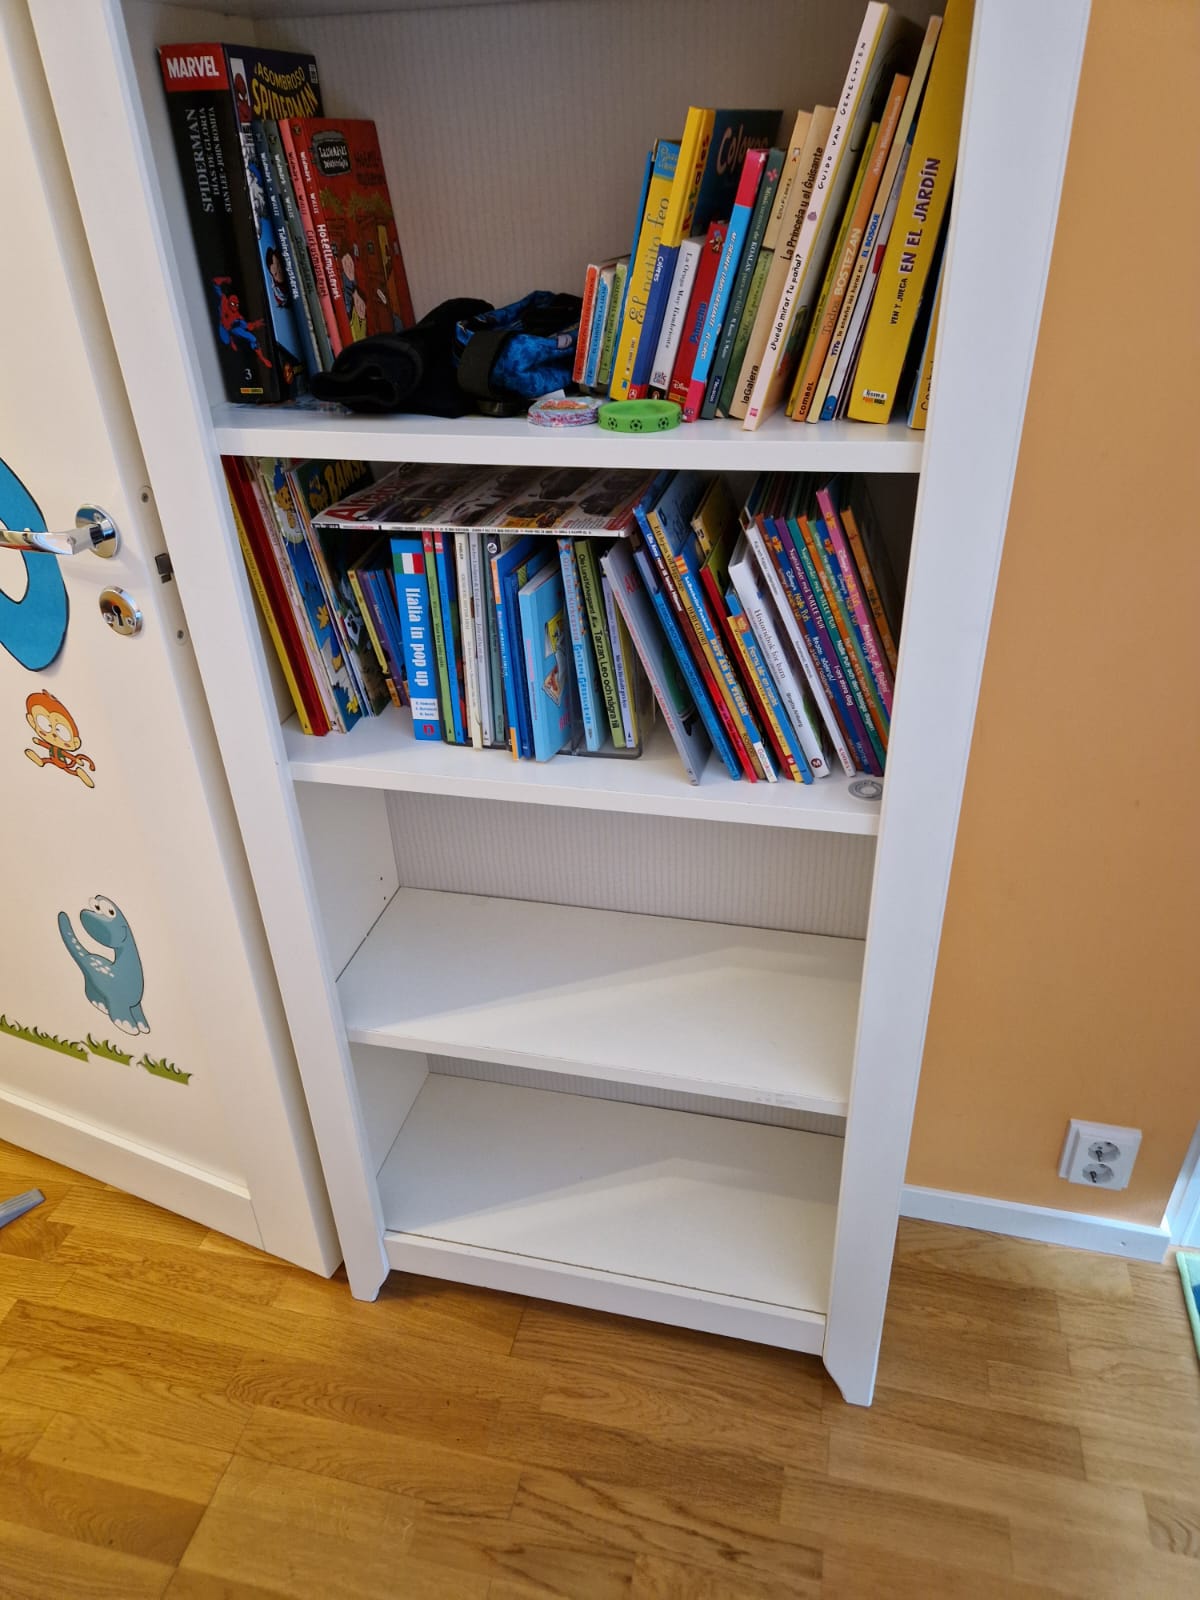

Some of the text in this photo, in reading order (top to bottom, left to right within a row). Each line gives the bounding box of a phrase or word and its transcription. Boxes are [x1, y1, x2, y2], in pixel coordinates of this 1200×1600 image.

[167, 56, 219, 79] MARVEL
[198, 108, 212, 150] GLORIA
[207, 106, 219, 141] ROMITA
[830, 124, 841, 146] VAN
[185, 108, 215, 213] SPIDERMAN
[214, 142, 224, 166] JOHN
[912, 157, 941, 222] JARDÍN
[781, 247, 793, 261] La
[804, 147, 823, 189] Guisante
[864, 213, 879, 246] BOSQUE
[906, 229, 923, 247] EL
[316, 224, 341, 299] Hotellmysteriet
[629, 296, 647, 325] El
[647, 198, 670, 226] feo
[744, 242, 757, 271] KOALAS
[831, 227, 862, 296] BOSTEZAN
[899, 252, 918, 273] EN
[896, 278, 909, 302] JUEGA
[778, 297, 790, 319] mirar
[890, 309, 899, 325] VEN
[244, 368, 253, 381] 3
[405, 587, 423, 622] Italia
[801, 580, 810, 593] med
[807, 594, 820, 615] NALLE
[815, 616, 825, 630] PUH
[818, 594, 831, 615] NALLE
[410, 627, 425, 639] in
[410, 643, 427, 667] pop
[415, 671, 429, 687] up
[599, 662, 609, 678] Leo
[603, 679, 612, 694] och
[839, 679, 849, 693] stora
[843, 694, 854, 707] dag
